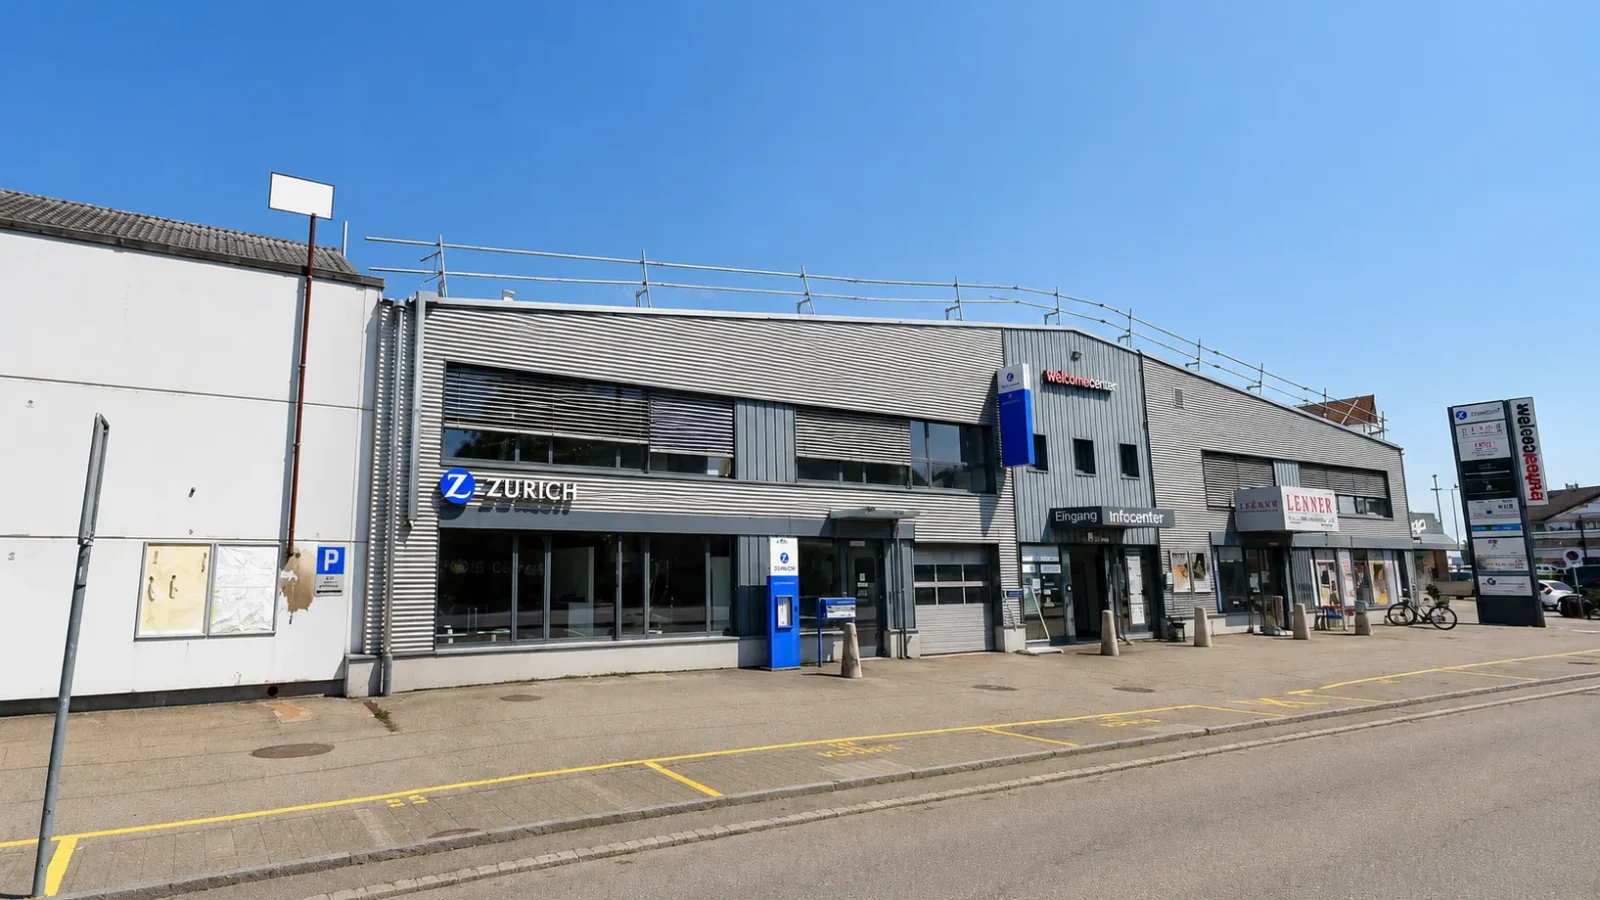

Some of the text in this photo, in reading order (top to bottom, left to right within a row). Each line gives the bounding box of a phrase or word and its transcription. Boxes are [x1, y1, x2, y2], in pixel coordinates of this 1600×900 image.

[485, 478, 577, 501] ZURICH
[1286, 494, 1332, 513] LENNER
[1055, 511, 1098, 523] Eingang
[1109, 510, 1164, 524] Infocenter
[324, 549, 339, 571] P
